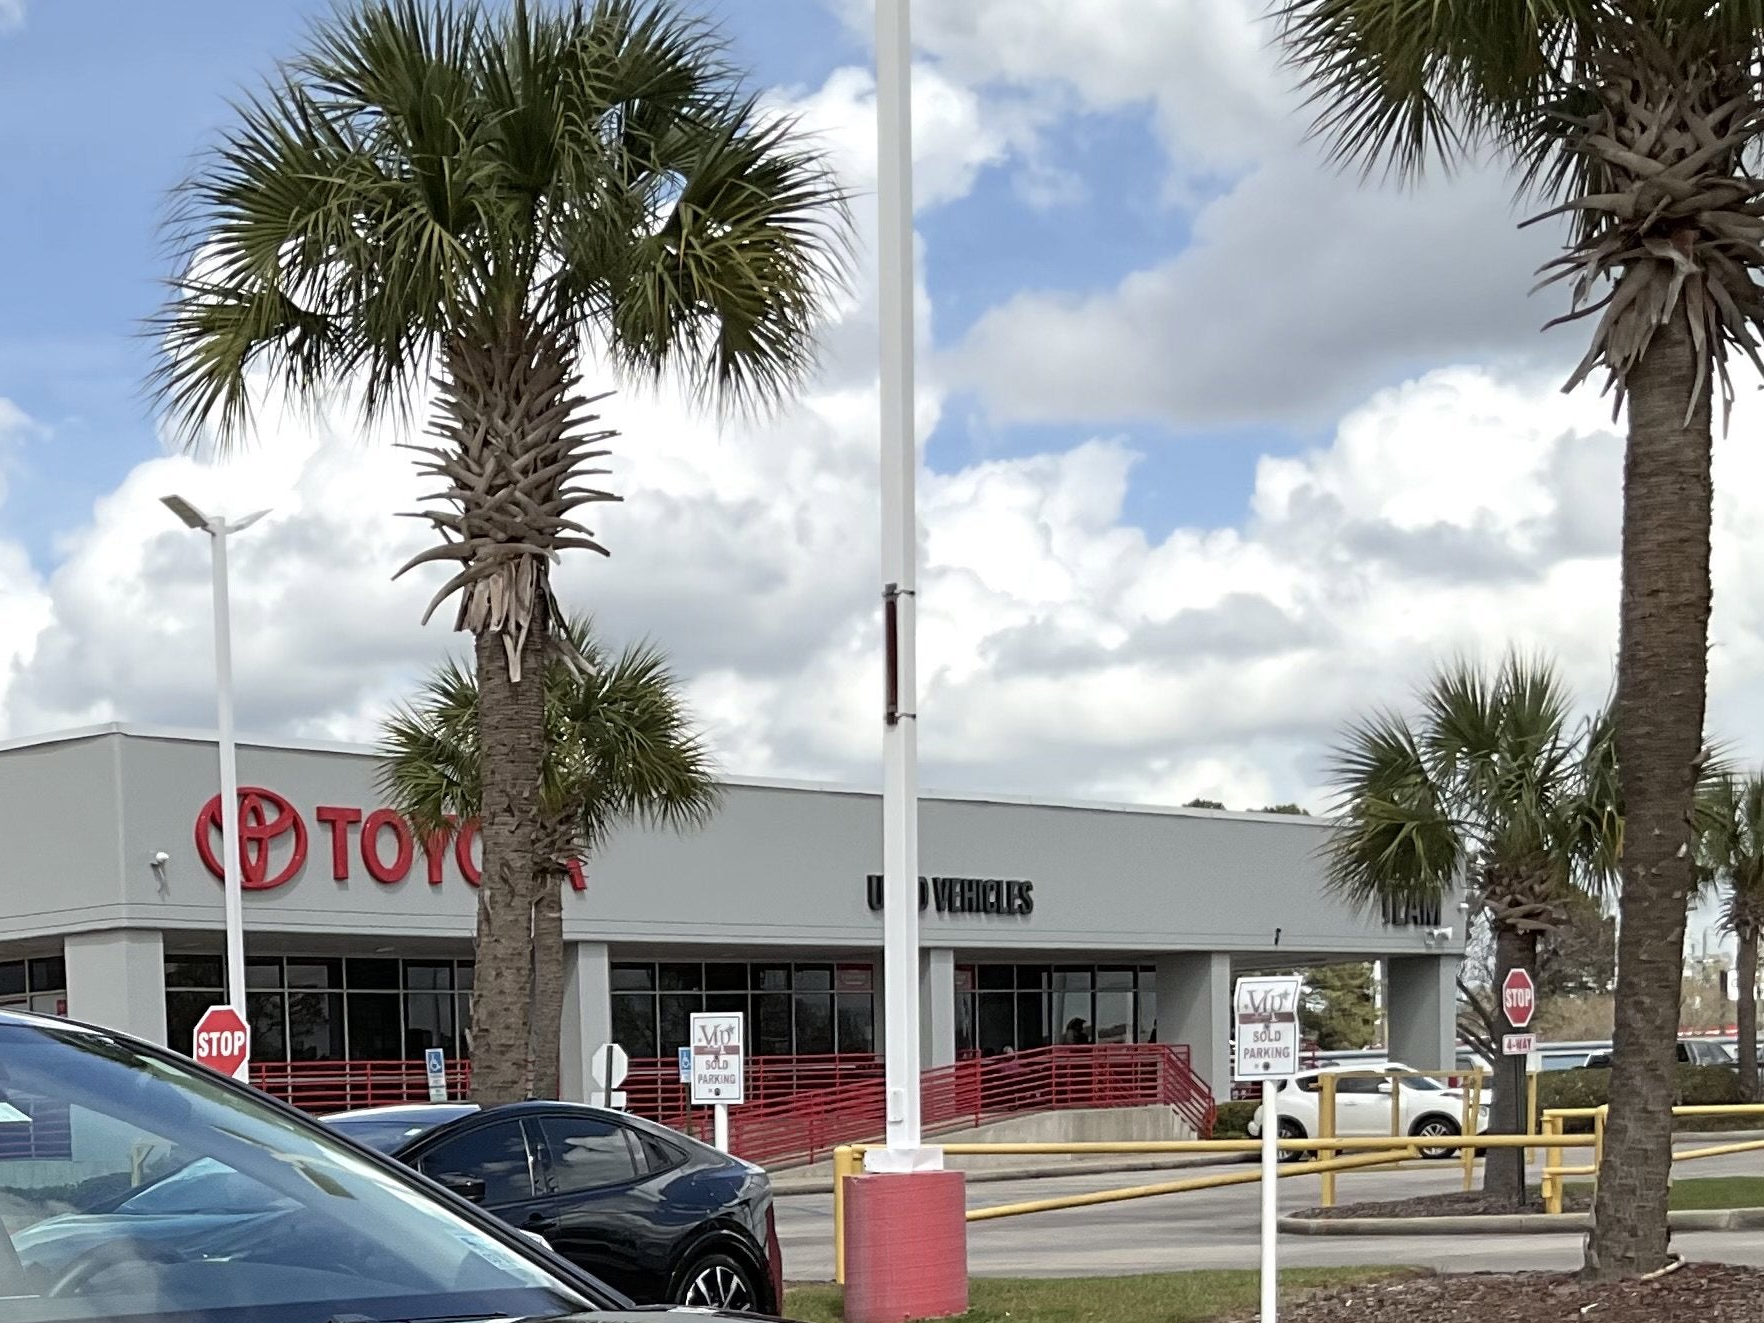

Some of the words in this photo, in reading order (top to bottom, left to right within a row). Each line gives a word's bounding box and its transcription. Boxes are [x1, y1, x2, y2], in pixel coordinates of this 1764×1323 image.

[316, 806, 587, 891] TOY
[867, 875, 929, 911] UD
[932, 877, 1034, 915] VEHICLES
[1505, 988, 1531, 1008] STOP
[1252, 1030, 1282, 1043] SOLD
[197, 1030, 245, 1058] STOP
[1506, 1038, 1532, 1051] 4-WAY
[1243, 1046, 1291, 1059] PARKING
[705, 1059, 729, 1070] SOLD
[697, 1073, 736, 1085] PARKING
